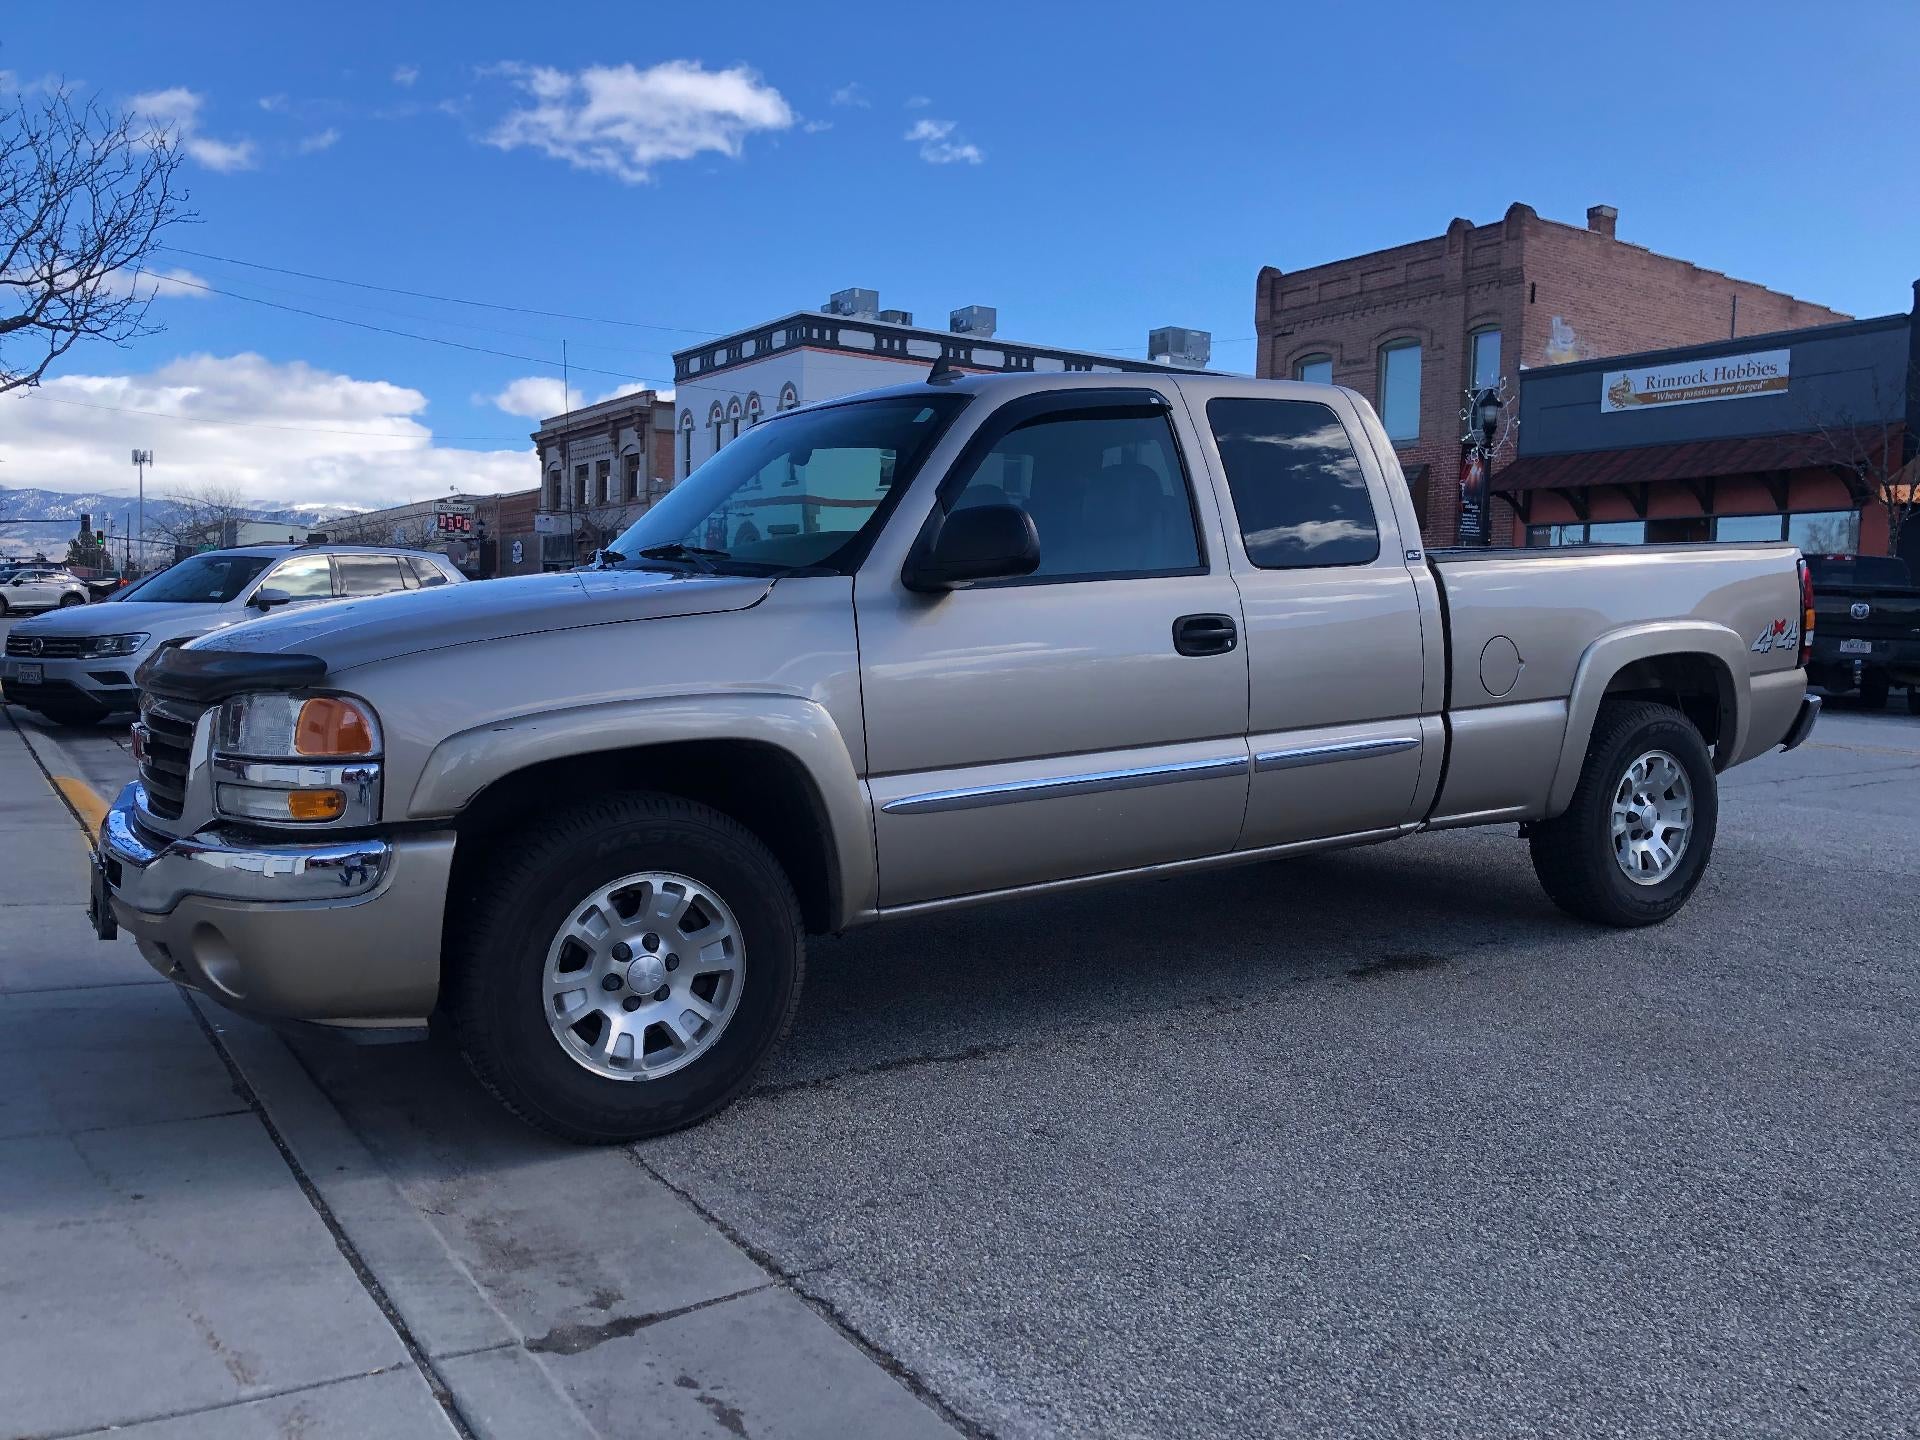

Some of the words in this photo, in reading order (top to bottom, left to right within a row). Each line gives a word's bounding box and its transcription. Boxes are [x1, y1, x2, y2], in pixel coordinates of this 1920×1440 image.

[1646, 368, 1708, 390] Rimrock
[1714, 361, 1777, 381] Hobbies
[1720, 385, 1735, 393] are
[439, 514, 471, 531] DRUG
